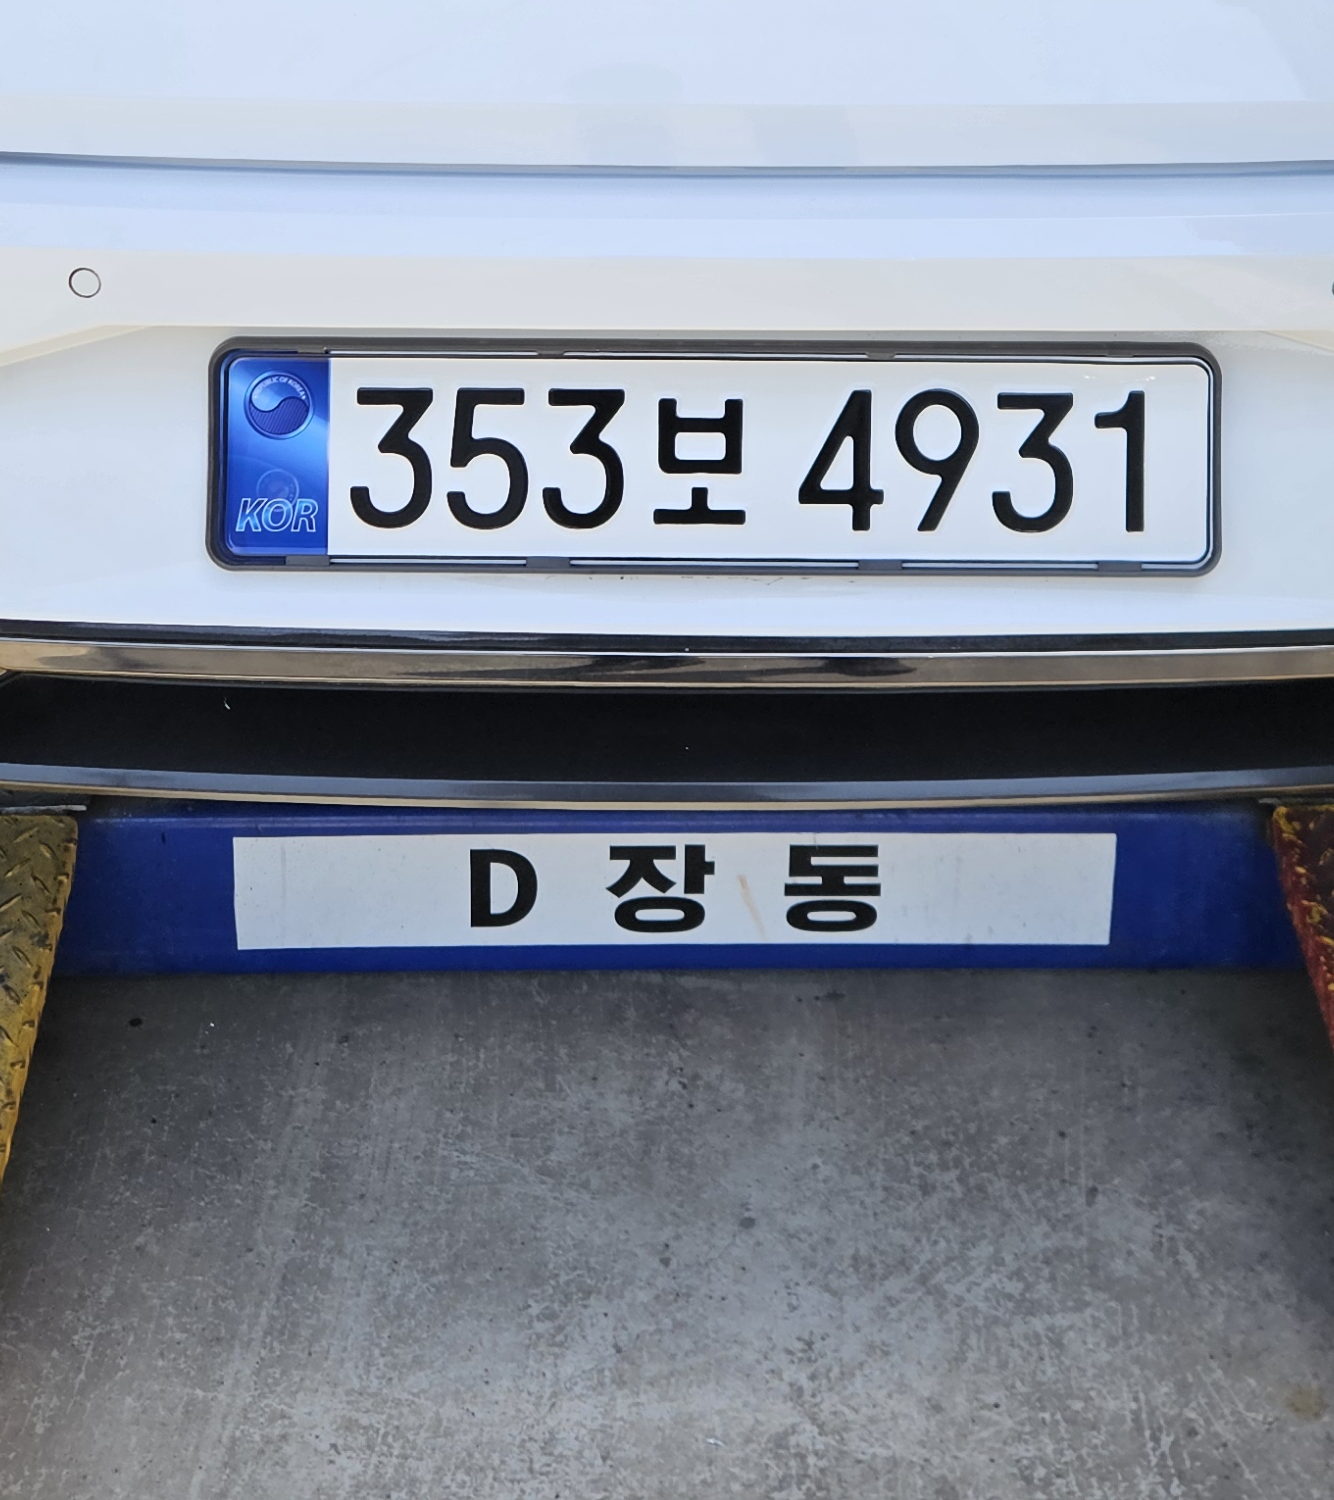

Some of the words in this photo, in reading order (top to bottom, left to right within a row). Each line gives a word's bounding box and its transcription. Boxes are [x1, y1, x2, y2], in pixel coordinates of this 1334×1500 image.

[350, 387, 746, 530] 353보
[798, 389, 1145, 533] 4931
[235, 497, 319, 533] KOR
[470, 849, 538, 928] D
